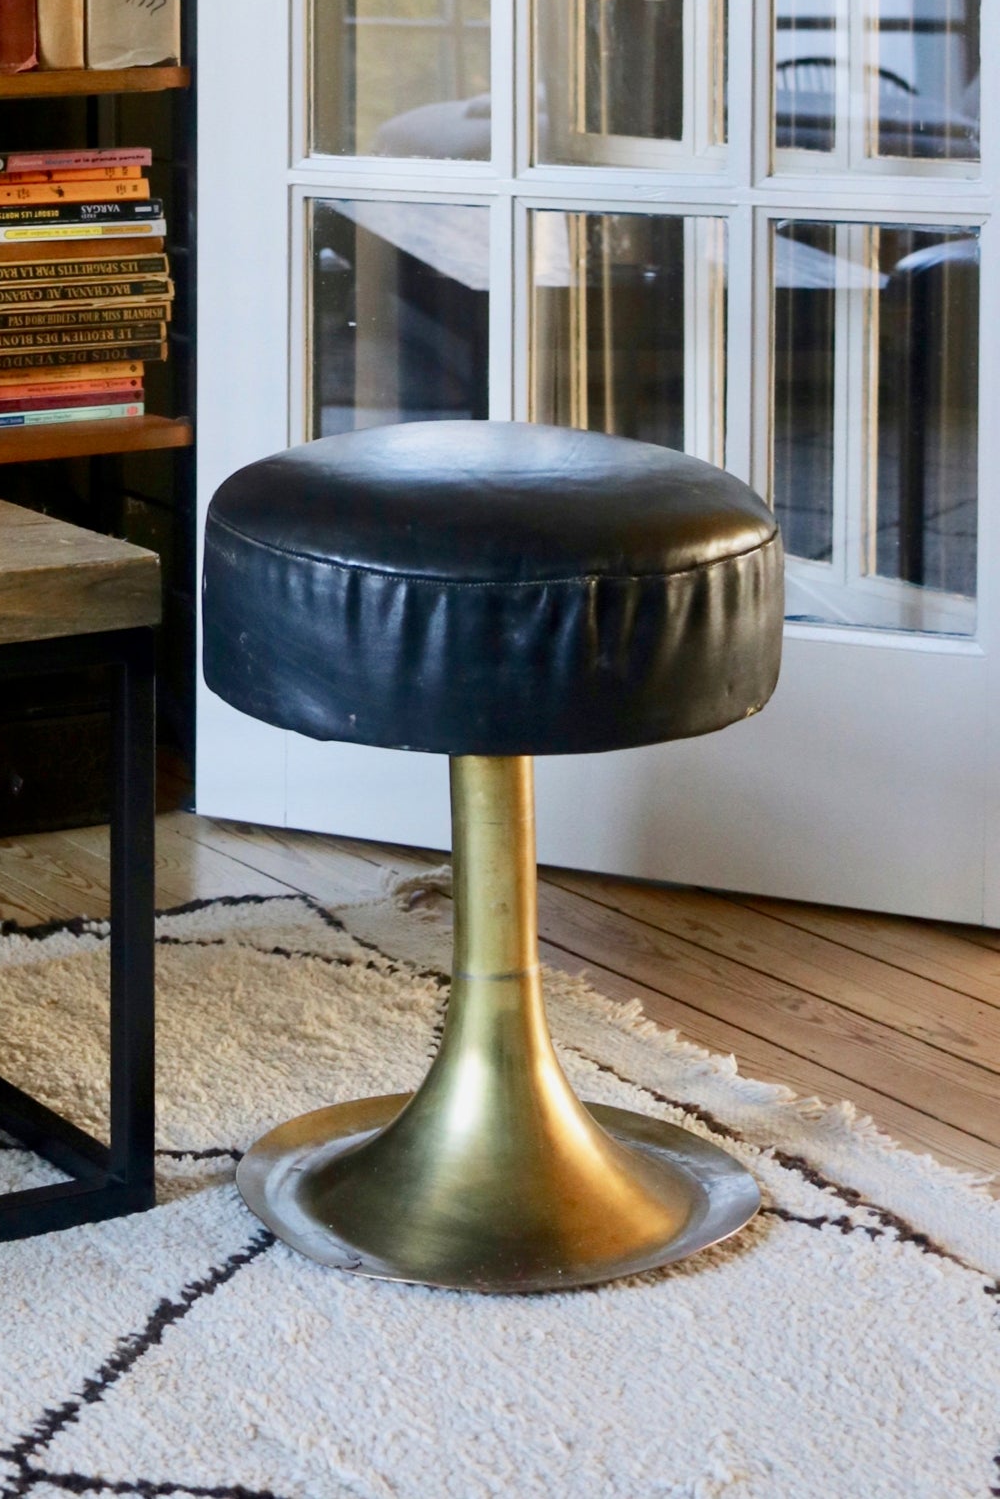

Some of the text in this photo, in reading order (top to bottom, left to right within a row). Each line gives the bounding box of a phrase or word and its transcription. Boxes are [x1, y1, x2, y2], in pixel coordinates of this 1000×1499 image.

[91, 156, 117, 164] grande
[119, 155, 145, 163] perche
[34, 209, 59, 218] DEBOUT
[80, 203, 120, 214] VARGAS
[19, 267, 33, 278] LA
[37, 266, 54, 278] PAR
[57, 262, 118, 277] SPAGHETTIS
[120, 261, 138, 273] LES
[47, 287, 61, 298] AU
[65, 283, 130, 297] BACCHANAL
[8, 307, 163, 325] PAS POUR MISS BLANDISH
[36, 333, 58, 345] DES
[61, 329, 114, 343] REQUIEM
[118, 327, 132, 340] LE
[57, 350, 86, 362] DES
[92, 348, 128, 361] TOUS
